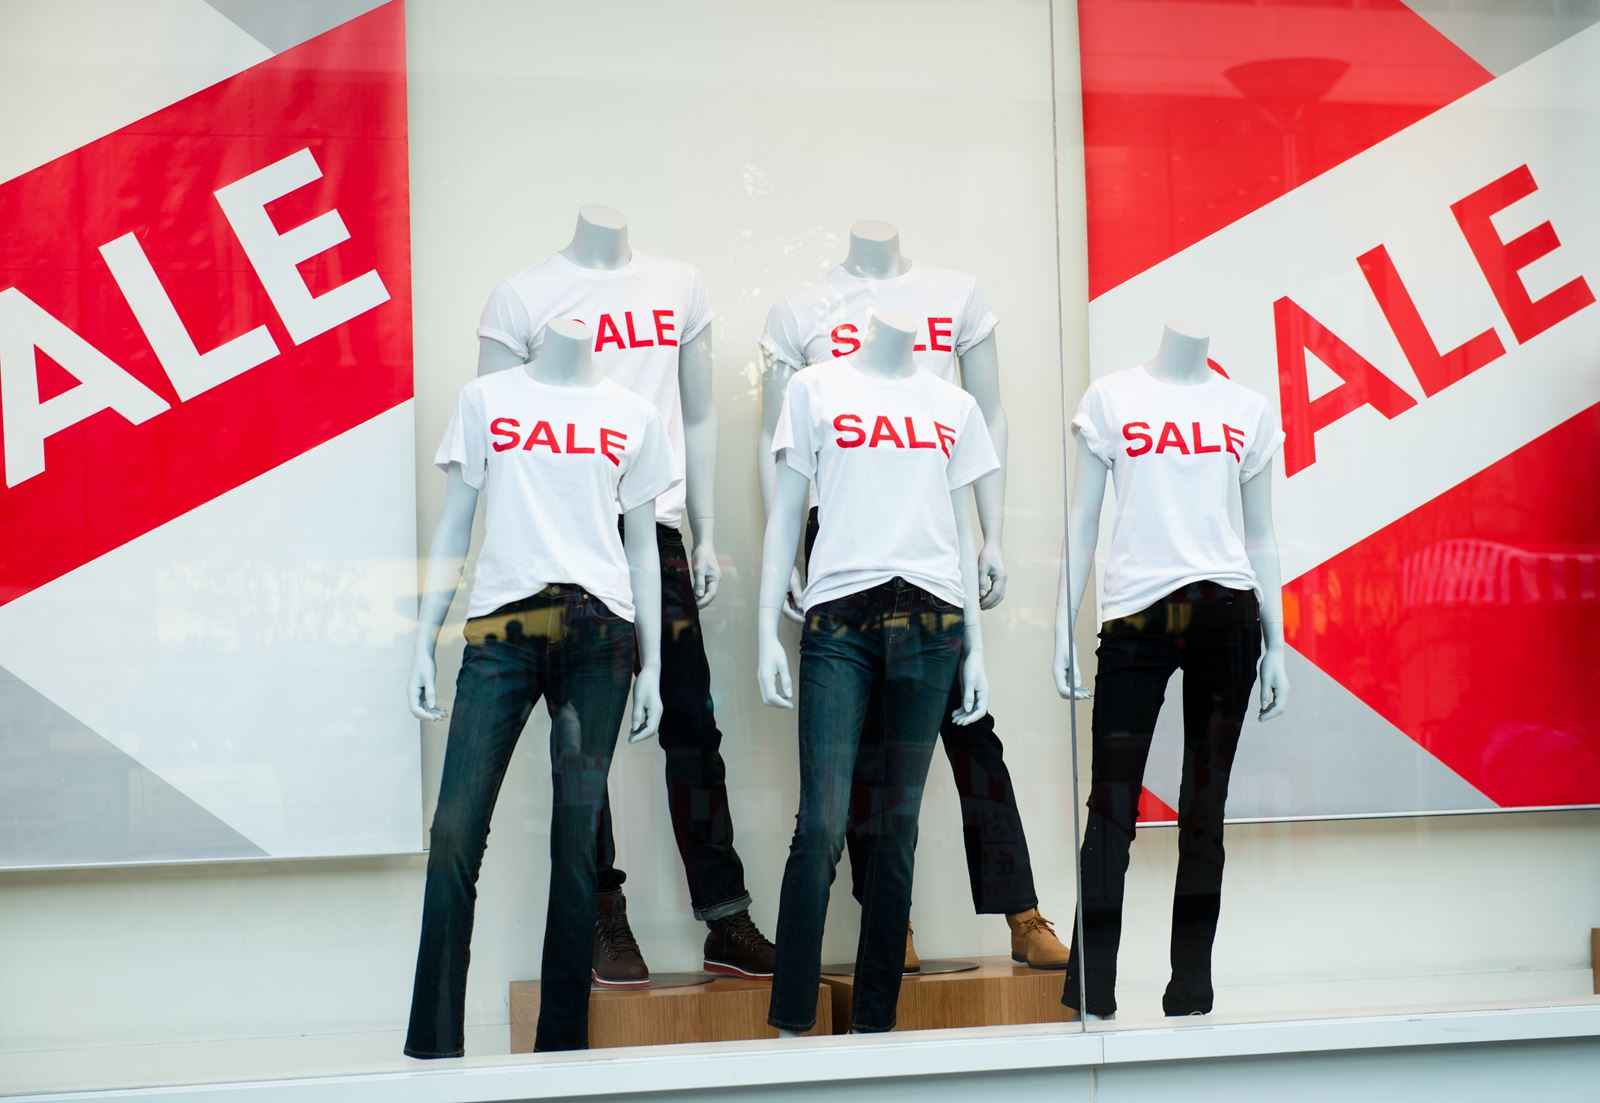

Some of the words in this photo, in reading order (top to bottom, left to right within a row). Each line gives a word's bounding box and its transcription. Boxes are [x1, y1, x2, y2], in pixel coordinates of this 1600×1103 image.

[0, 146, 391, 488] ALE
[573, 310, 678, 353] ALE
[831, 317, 953, 358] SE
[1206, 163, 1597, 479] ALE
[490, 416, 628, 466] SALE
[833, 413, 957, 460] SALE
[1121, 421, 1246, 463] SALE
